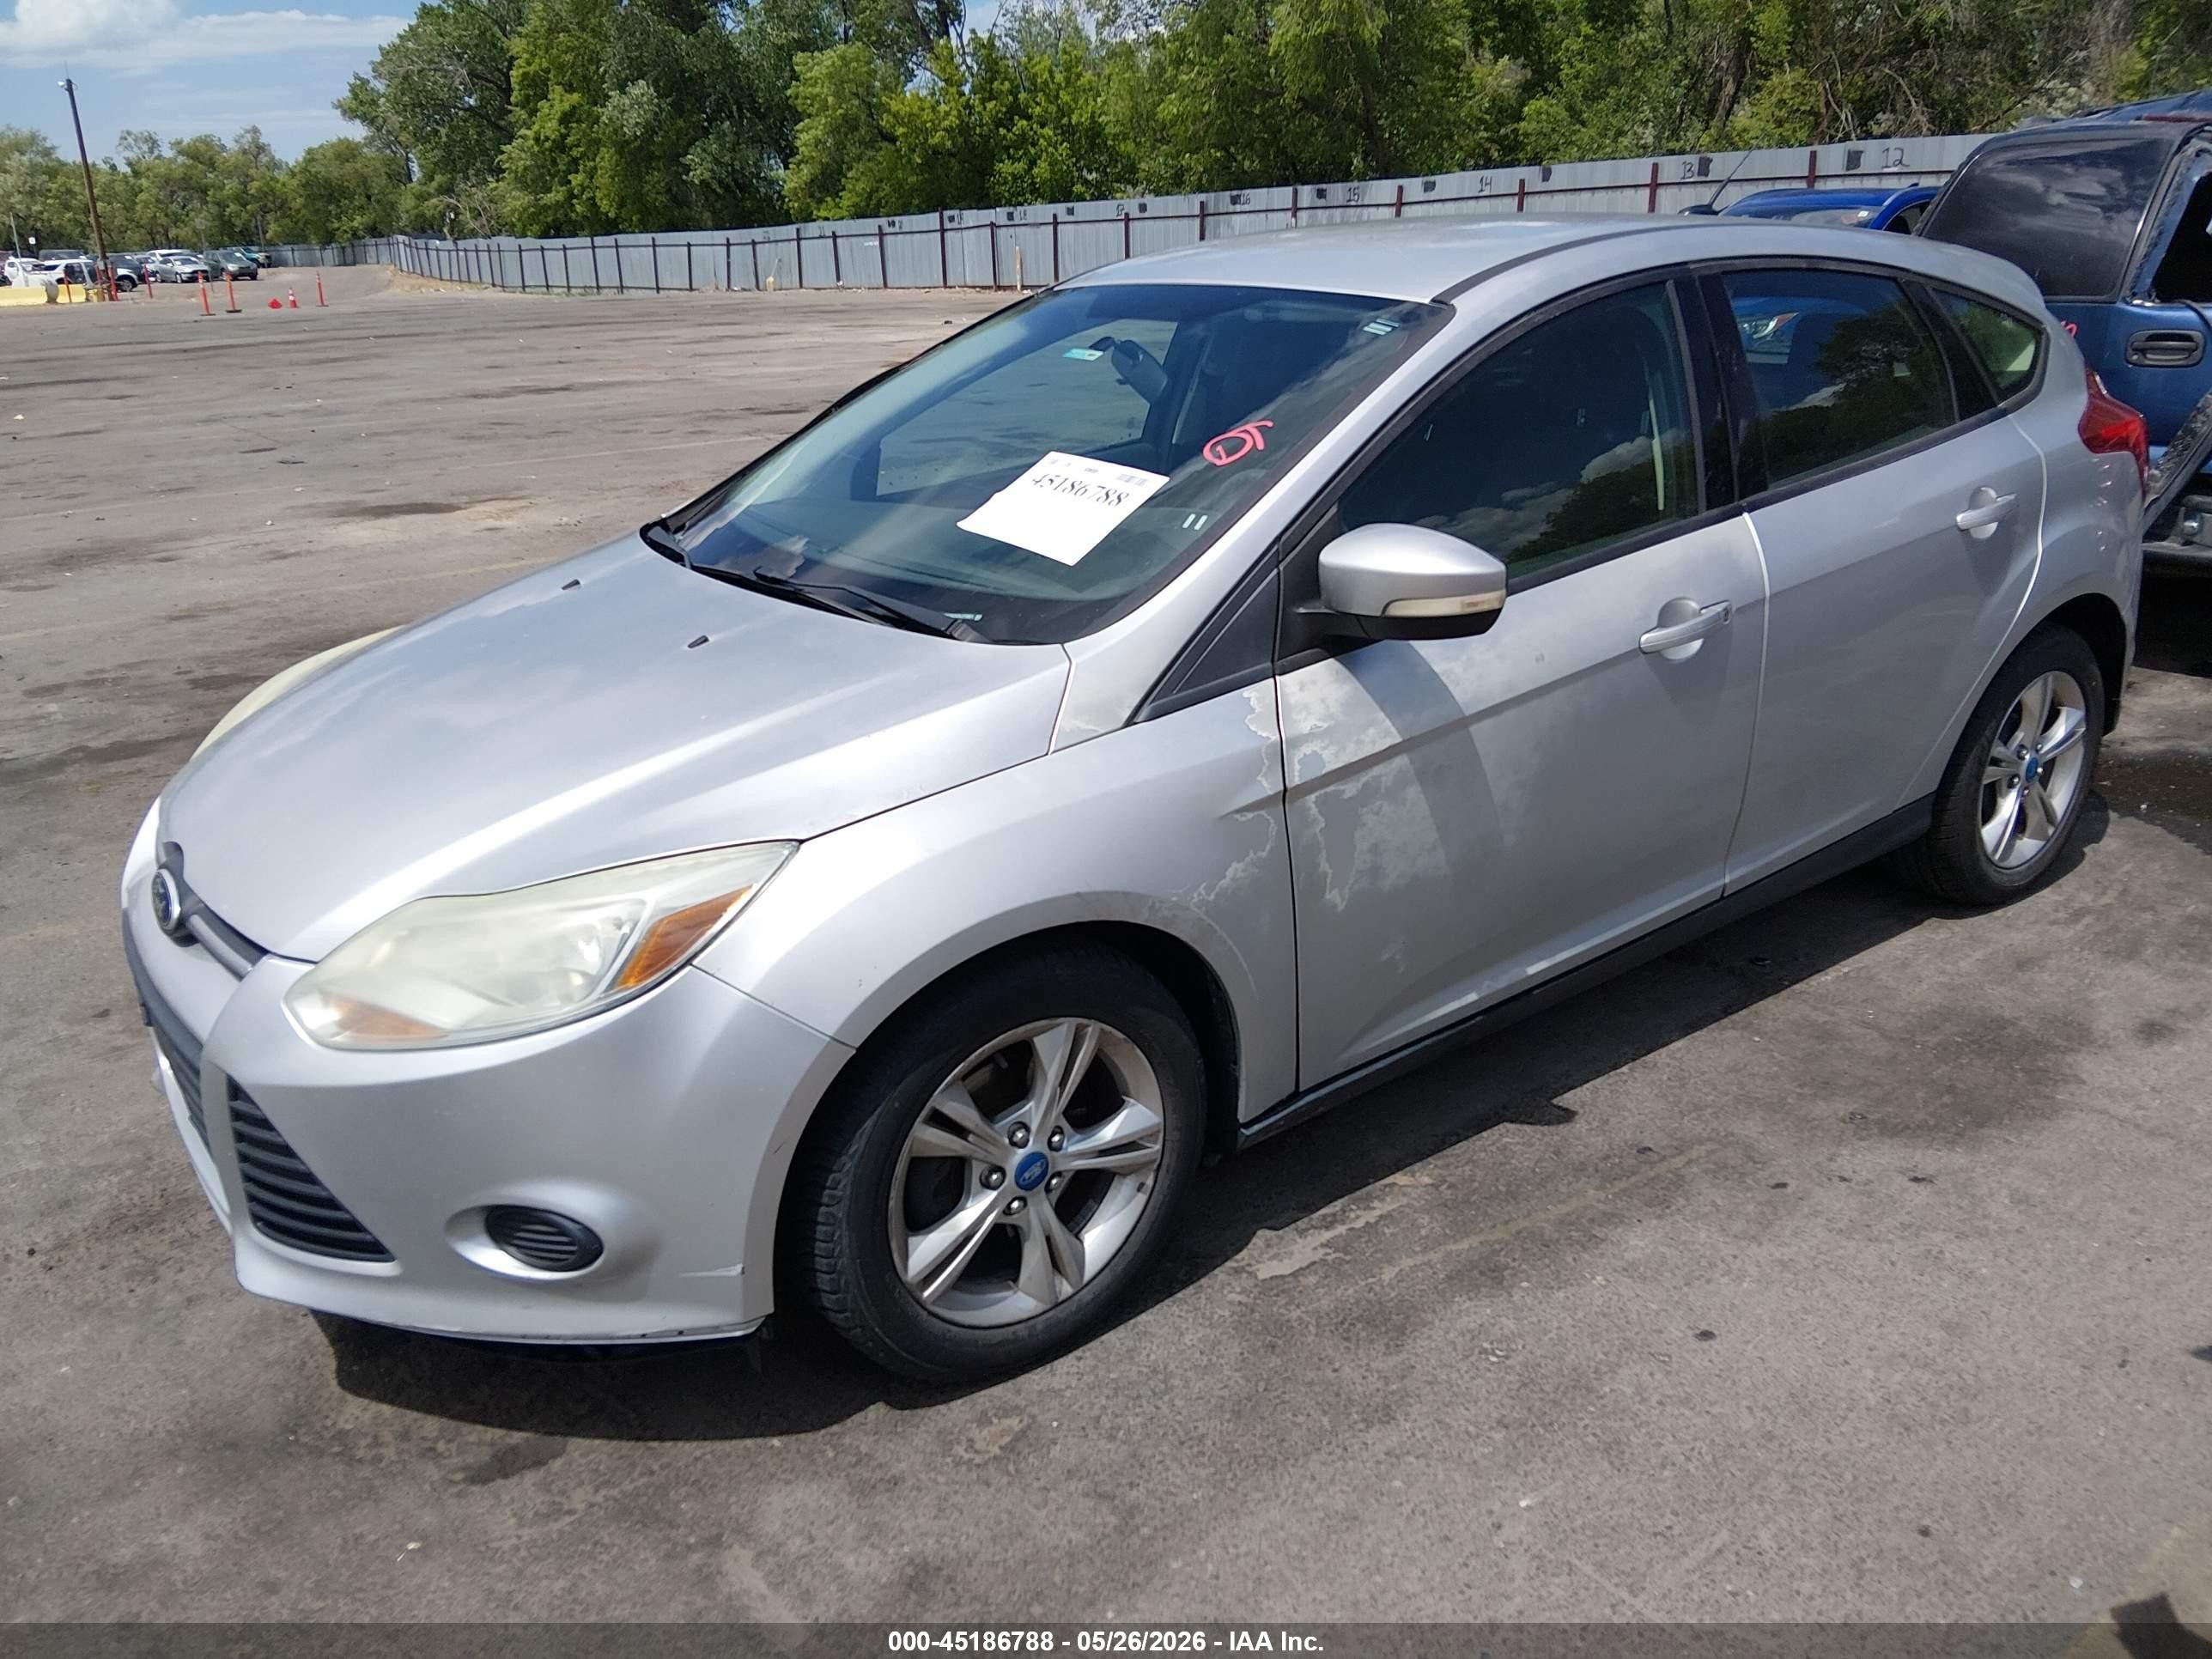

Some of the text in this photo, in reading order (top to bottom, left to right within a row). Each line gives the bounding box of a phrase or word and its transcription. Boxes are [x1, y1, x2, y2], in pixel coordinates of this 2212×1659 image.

[1881, 147, 1911, 168] 12
[1478, 175, 1492, 193] 14
[1346, 186, 1360, 203] 15
[1032, 473, 1130, 507] 45186788
